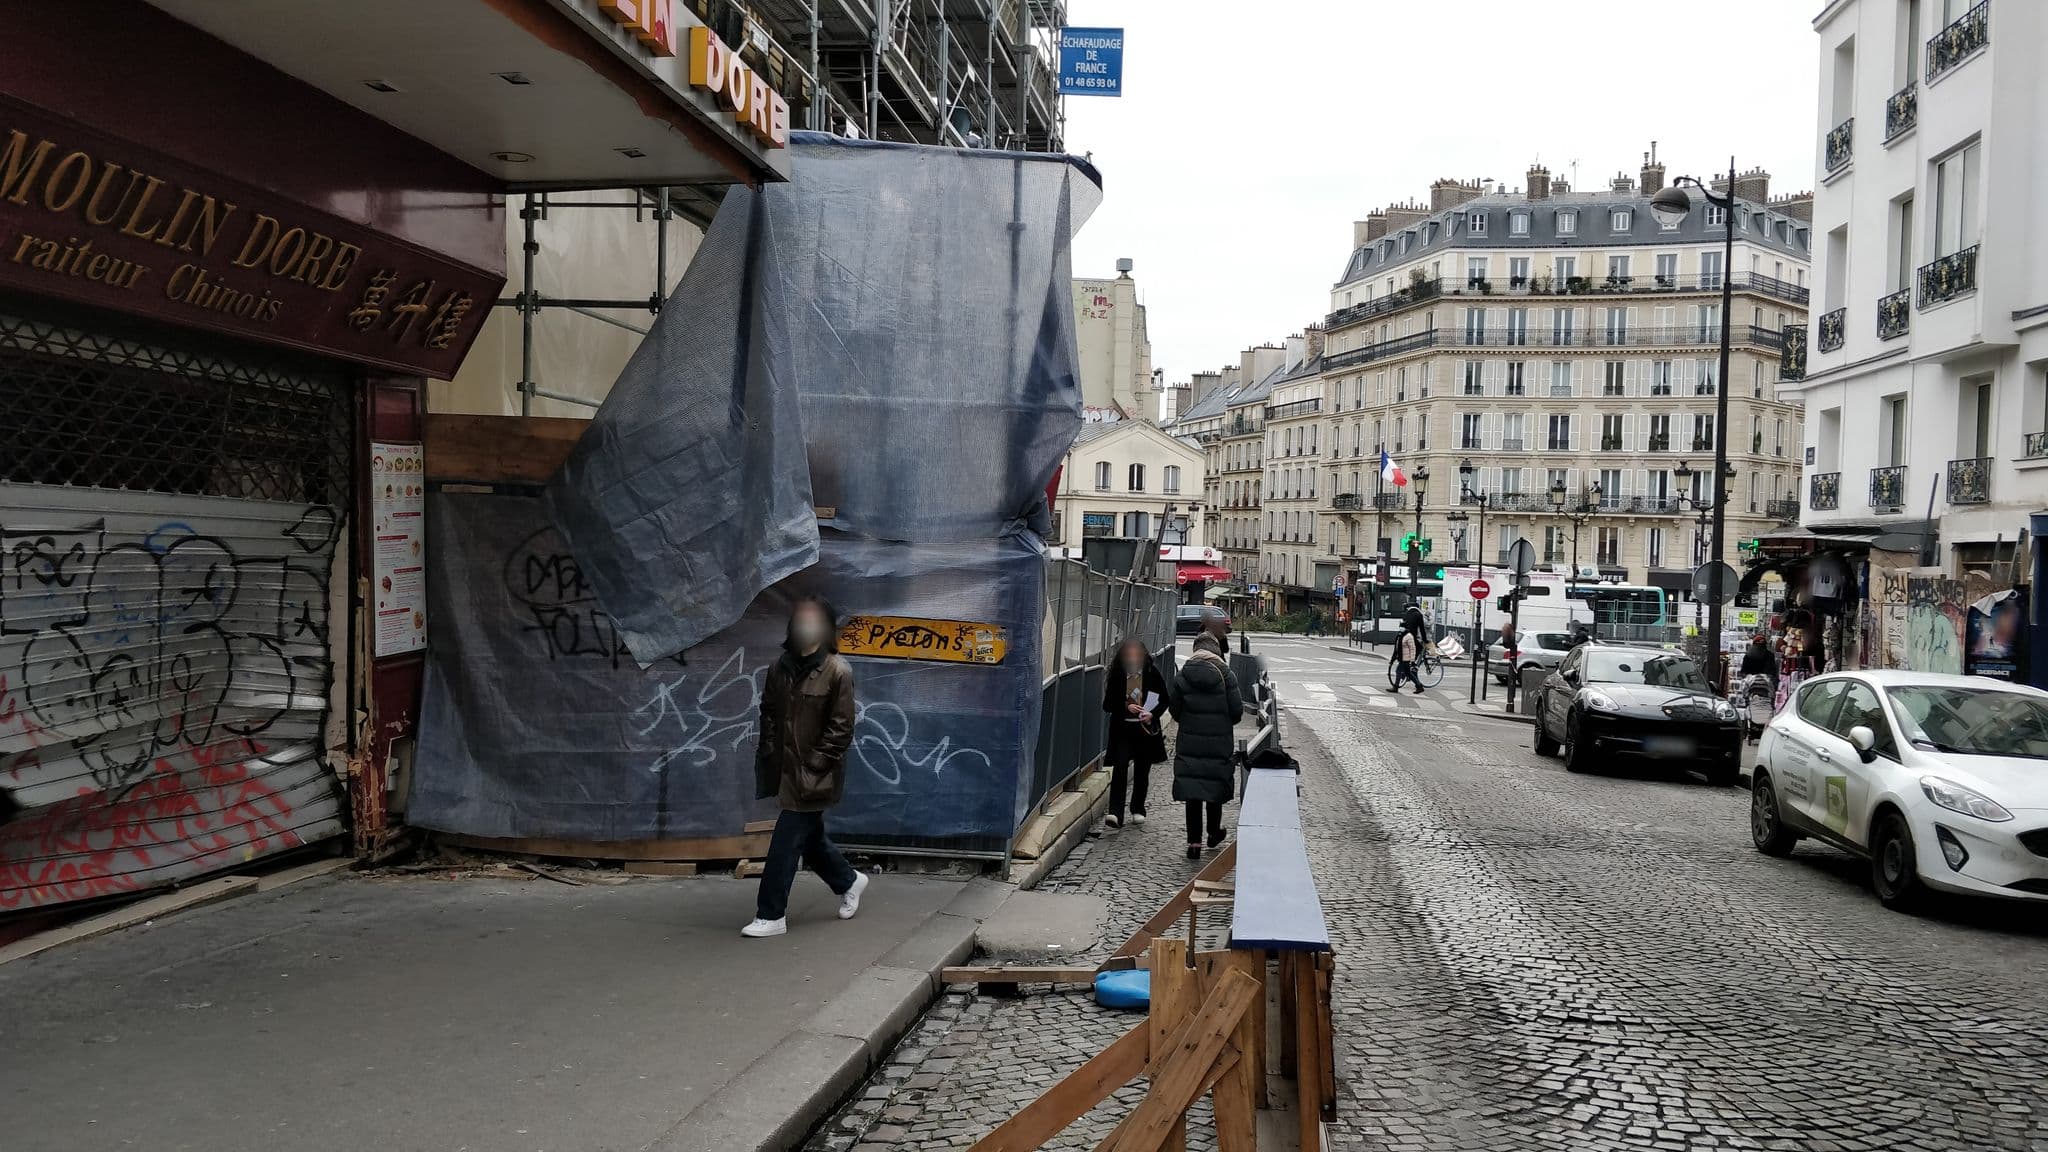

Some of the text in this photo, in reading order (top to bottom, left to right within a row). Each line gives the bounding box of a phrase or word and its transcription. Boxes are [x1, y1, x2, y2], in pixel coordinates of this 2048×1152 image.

[1063, 35, 1121, 49] ÉCHAFAUDAGE
[1086, 50, 1098, 61] DE
[1075, 62, 1107, 74] FRANCE
[690, 26, 790, 149] DORE
[1065, 77, 1117, 88] 01 48 65 93 04
[0, 129, 363, 293] MOULIN DORE
[8, 233, 284, 322] raiteur Chinois
